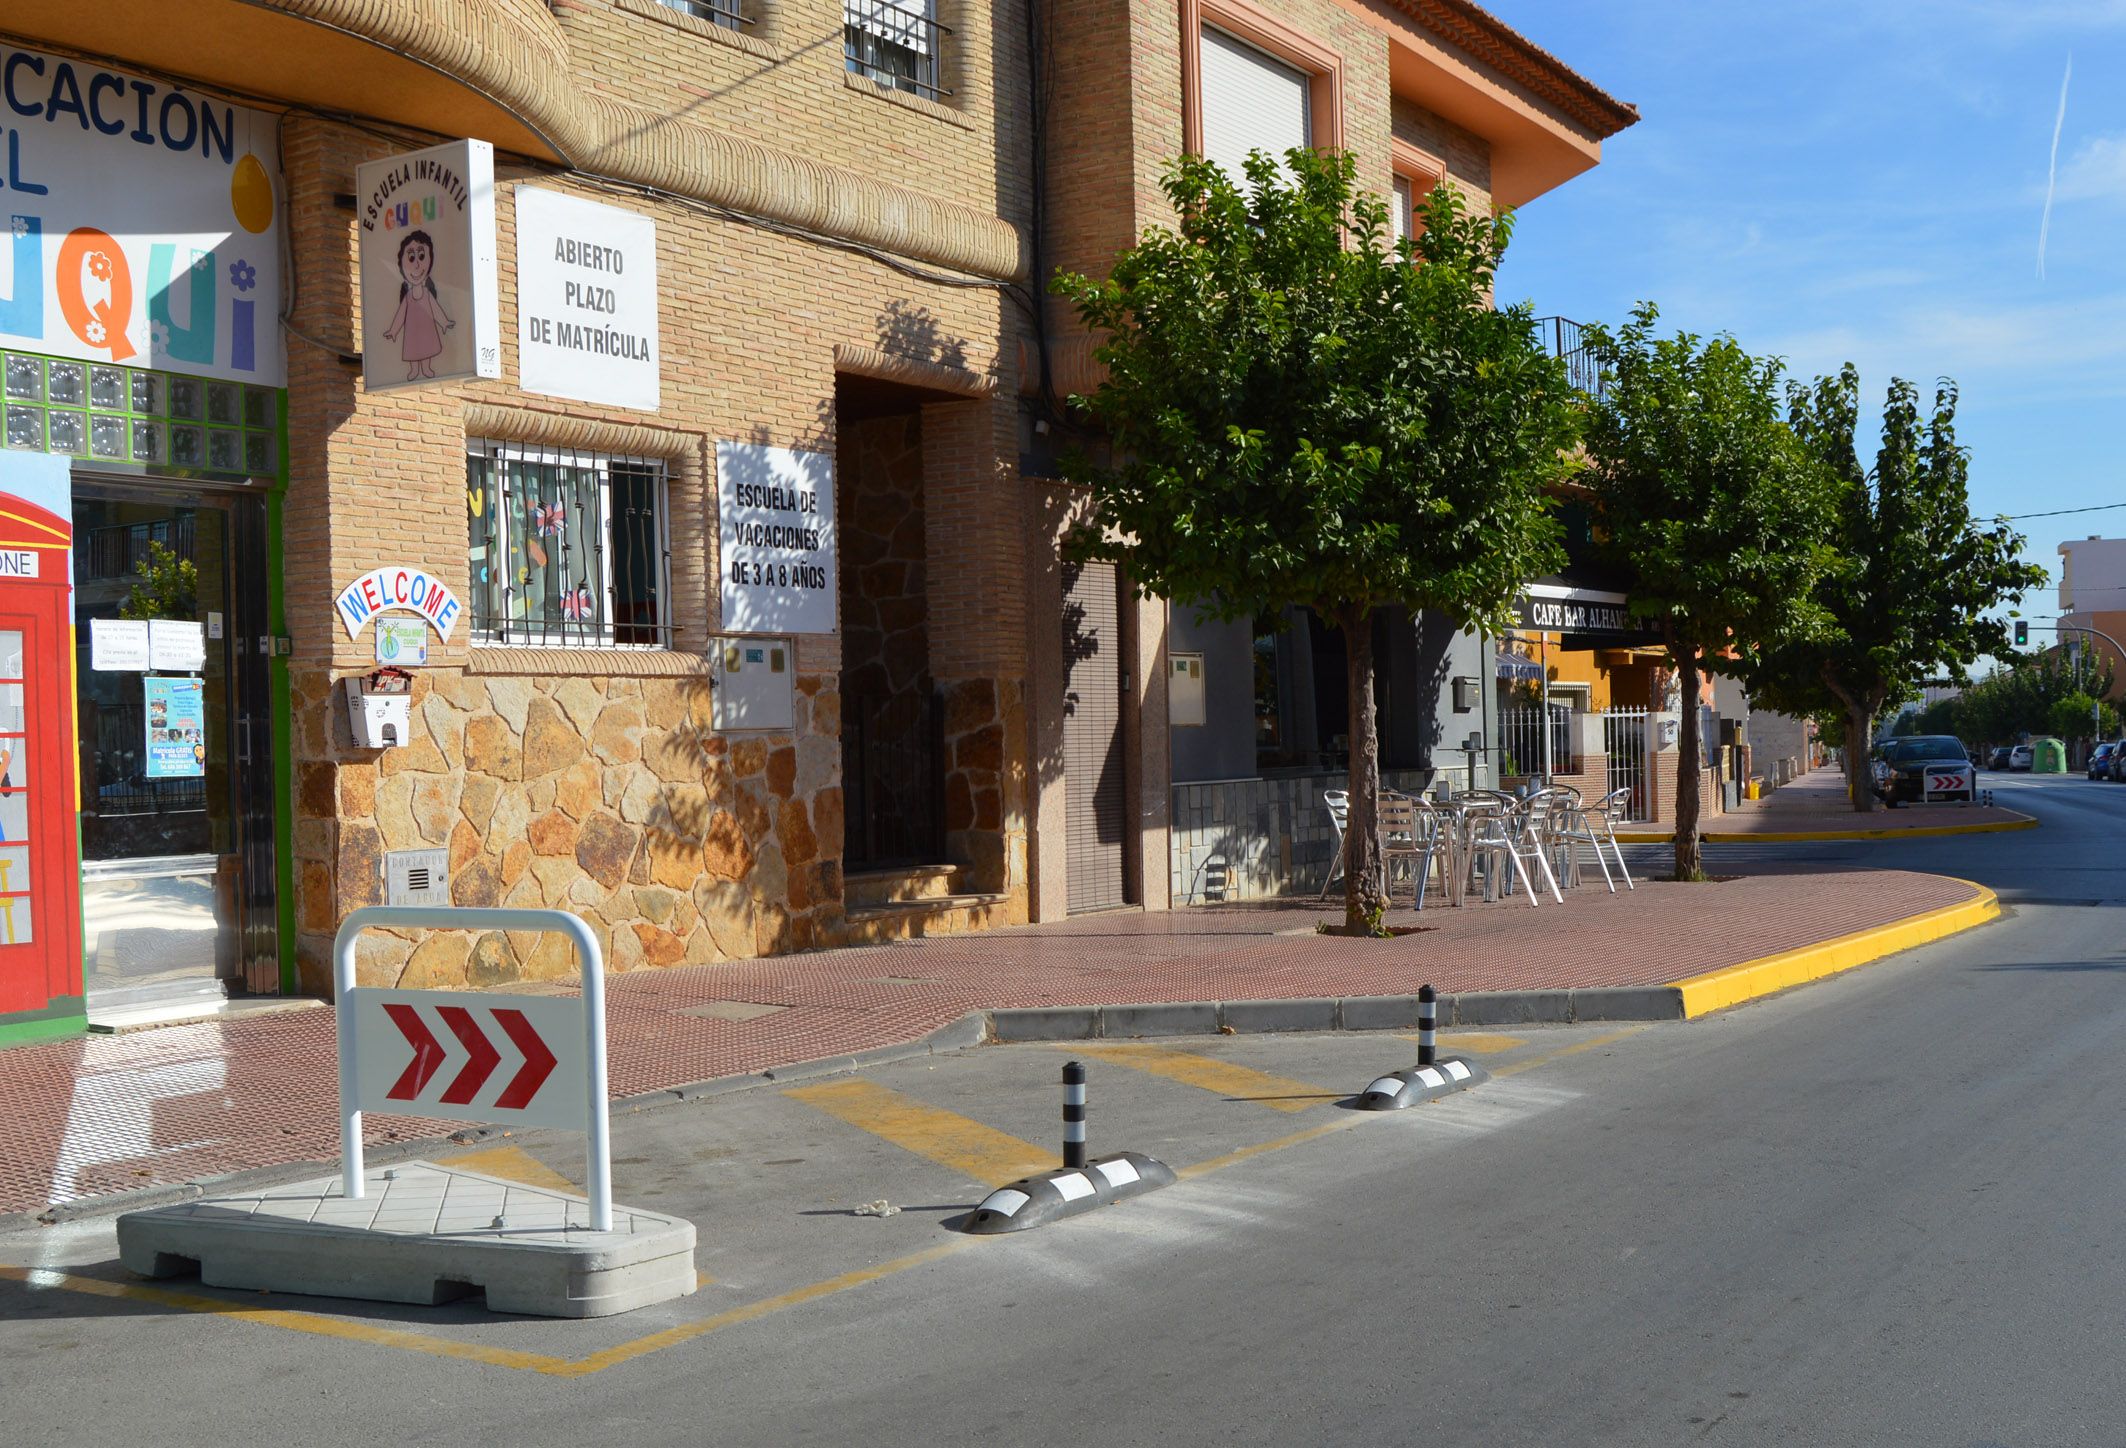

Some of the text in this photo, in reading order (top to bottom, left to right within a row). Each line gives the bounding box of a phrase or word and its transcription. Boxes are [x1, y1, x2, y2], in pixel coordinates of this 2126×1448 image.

[0, 51, 234, 165] CACIÓN
[363, 159, 468, 232] ESCUELA INFANTIL
[555, 237, 624, 275] ABIERTO
[565, 281, 616, 315] PLAZO
[530, 316, 650, 362] DE MATRÍCULA
[736, 483, 816, 514] ESCUELA DE
[735, 522, 819, 552] VACACIONES
[731, 560, 826, 590] DE 3 A 8 AÑOS
[341, 571, 459, 630] WELCOME
[1533, 603, 1563, 627] CAFE
[1565, 605, 1587, 628] BAR
